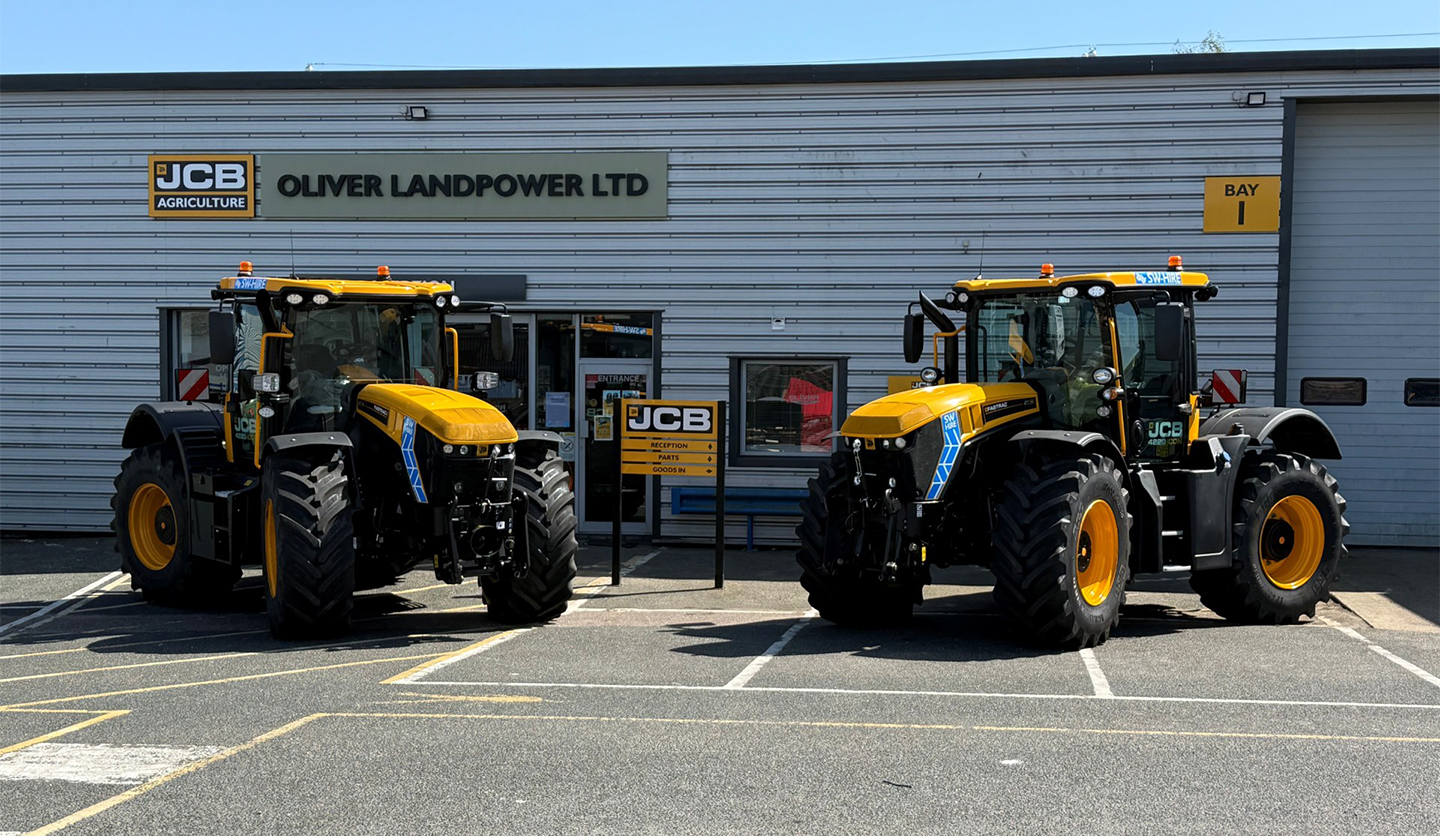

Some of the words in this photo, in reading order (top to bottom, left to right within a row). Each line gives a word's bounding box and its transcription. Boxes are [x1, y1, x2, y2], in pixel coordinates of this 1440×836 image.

[156, 163, 245, 190] JCB
[277, 174, 384, 198] OLIVER
[390, 173, 584, 197] LANDPOWER
[592, 173, 649, 197] LTD
[1225, 184, 1259, 197] BAY
[157, 197, 246, 209] AGRICULTURE
[241, 279, 266, 289] SW-HIRE
[1147, 272, 1181, 284] SW-HIRE
[597, 375, 640, 383] ENTRANCE
[629, 406, 711, 431] JCB
[944, 411, 955, 423] SW
[944, 421, 958, 431] HIRE
[1148, 421, 1183, 438] JCB
